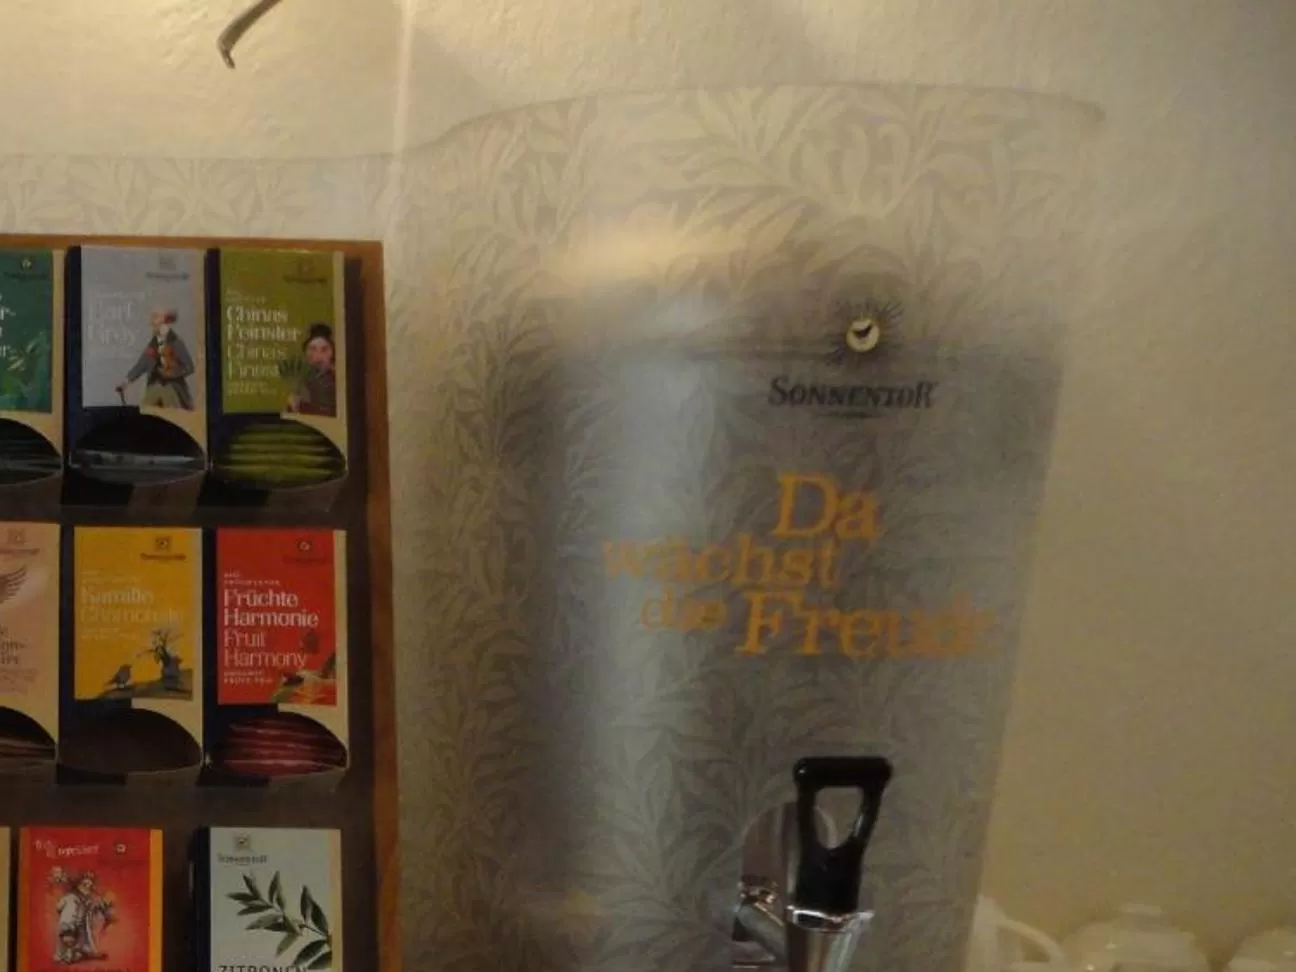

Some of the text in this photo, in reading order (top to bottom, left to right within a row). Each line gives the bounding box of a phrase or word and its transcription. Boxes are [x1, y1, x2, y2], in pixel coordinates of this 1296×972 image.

[768, 374, 939, 411] SONNENTOR
[772, 471, 884, 542] Da
[223, 589, 299, 608] Früchte
[223, 608, 321, 629] Harmonie
[223, 630, 266, 648] Fruit
[223, 649, 307, 669] Harmony
